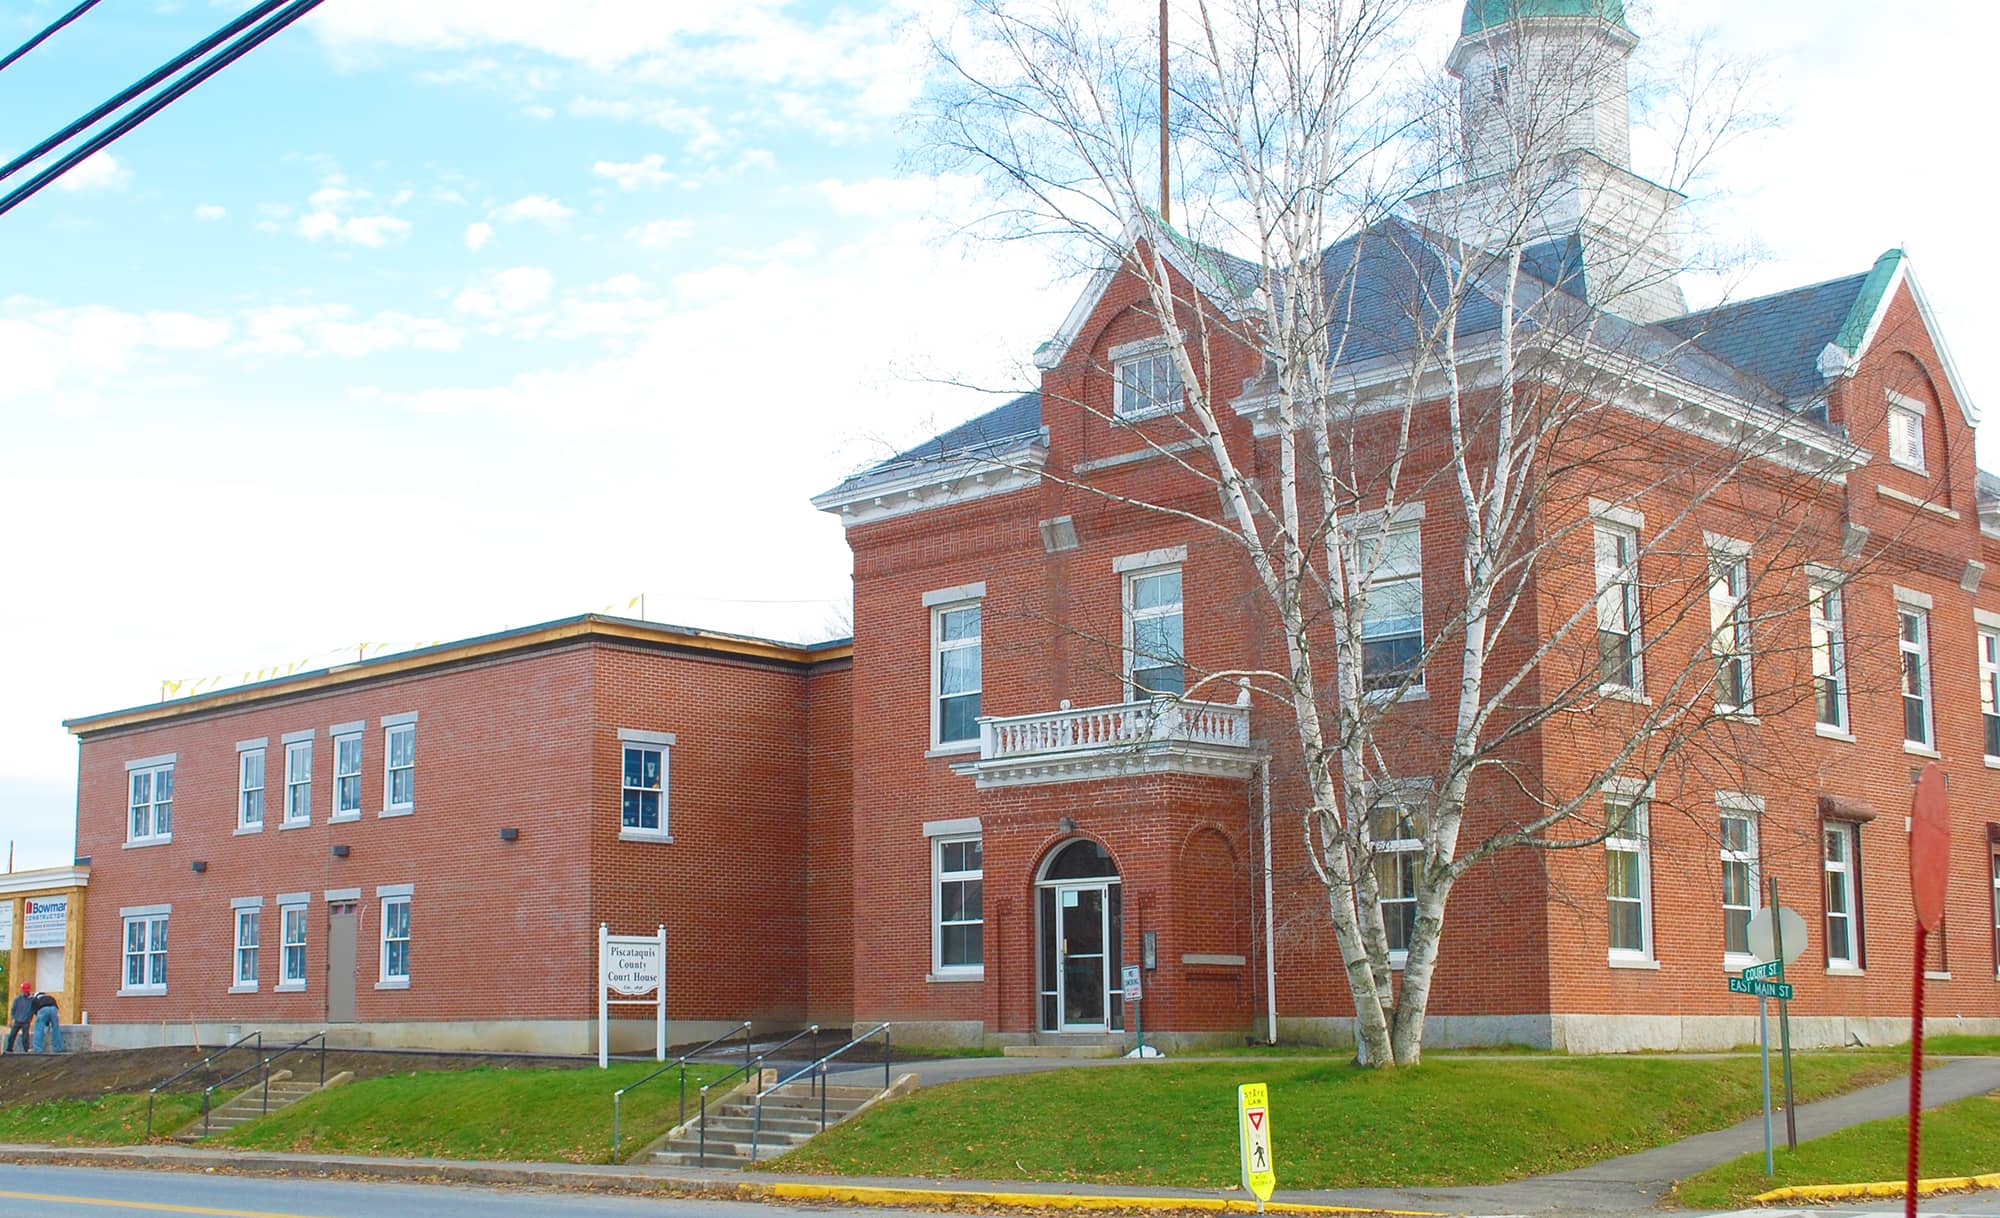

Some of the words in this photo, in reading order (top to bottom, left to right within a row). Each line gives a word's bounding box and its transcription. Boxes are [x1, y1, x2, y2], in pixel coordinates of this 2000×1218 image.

[611, 947, 656, 960] Piscataquis
[619, 959, 647, 971] County
[608, 971, 630, 982] Court
[634, 972, 658, 982] House
[1745, 965, 1766, 981] COURT
[1768, 963, 1777, 976] ST
[1730, 979, 1751, 993] EAST
[1754, 982, 1776, 996] MAIN
[1778, 984, 1790, 998] ST
[1244, 1088, 1265, 1099] STATE
